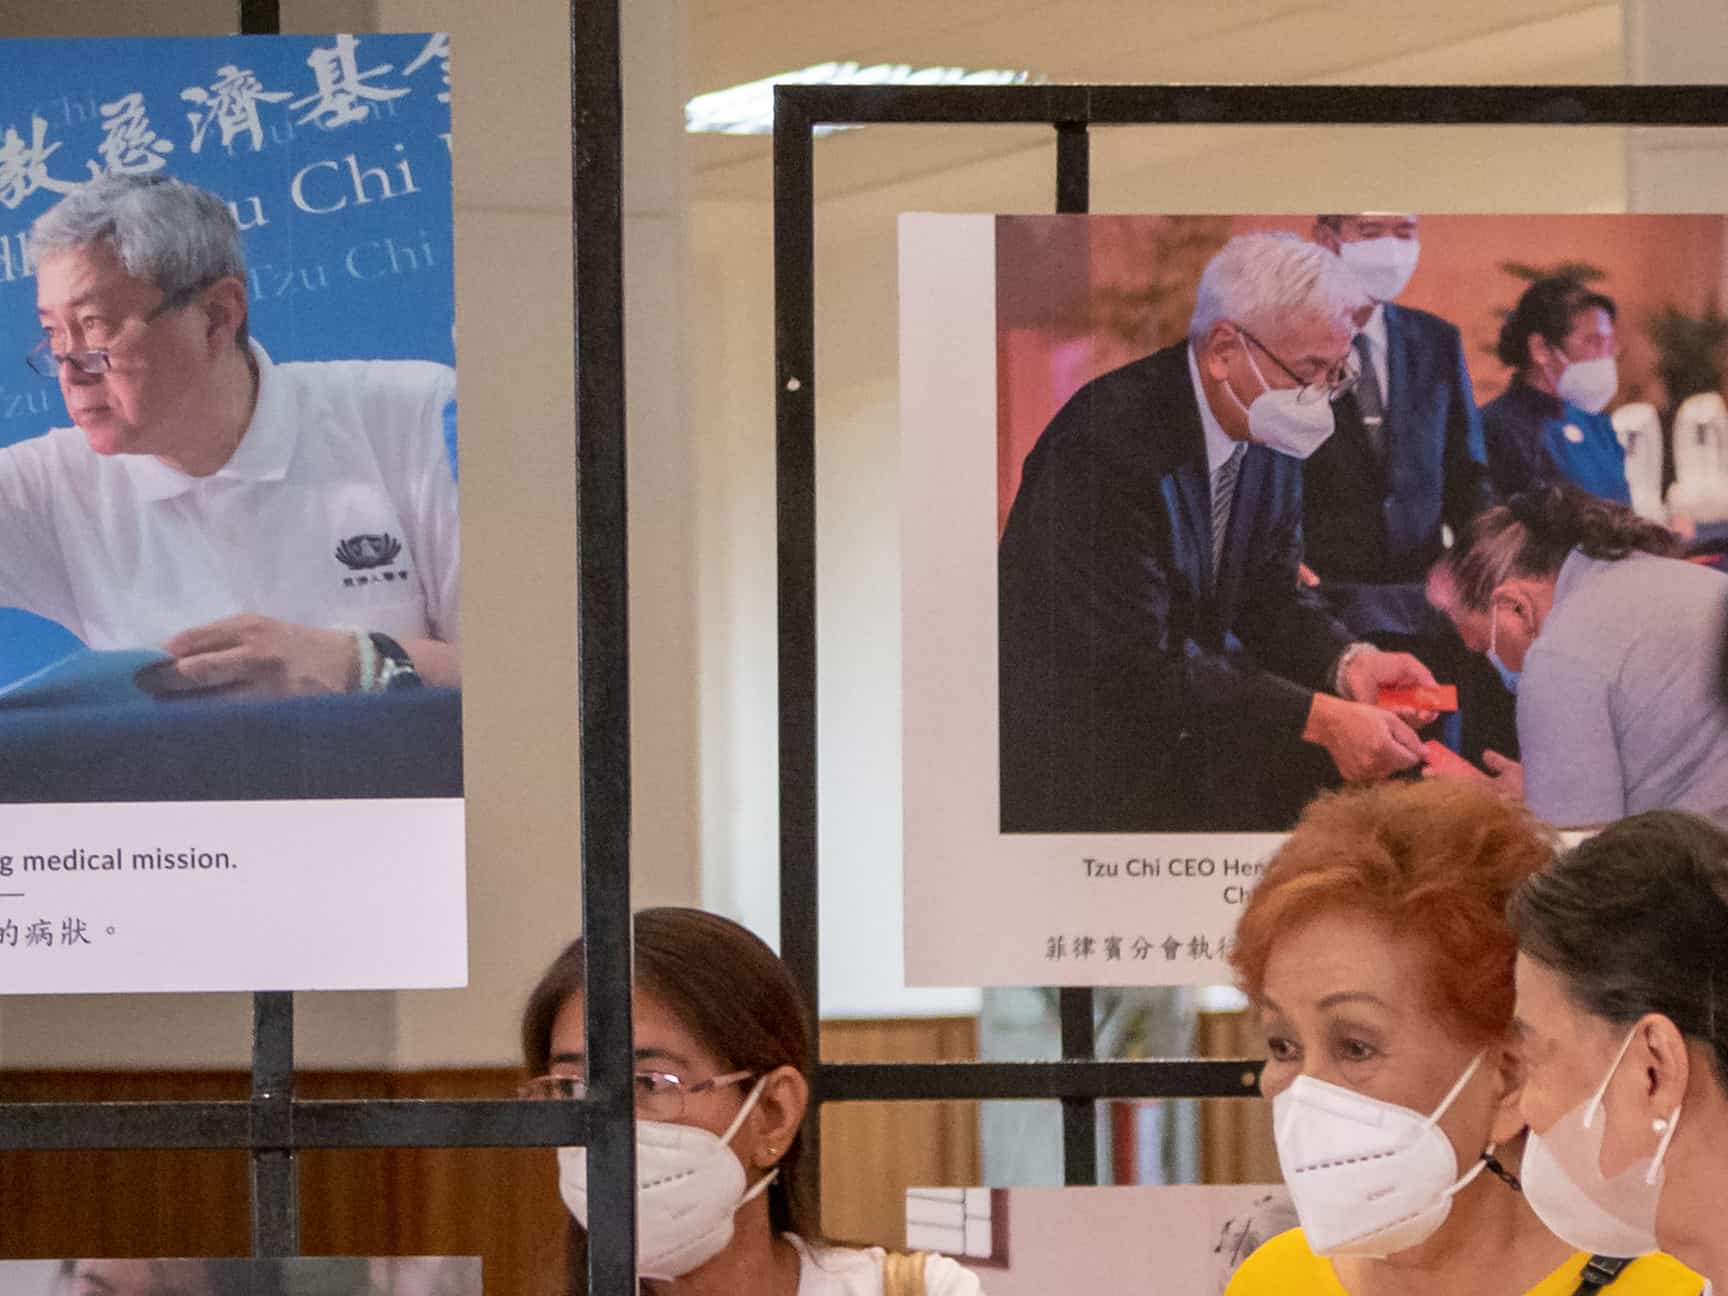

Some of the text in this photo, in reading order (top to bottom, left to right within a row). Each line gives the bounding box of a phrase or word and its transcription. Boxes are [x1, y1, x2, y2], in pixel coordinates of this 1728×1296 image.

[291, 144, 420, 213] Chi
[346, 229, 436, 281] Chi
[23, 848, 122, 872] medical
[132, 847, 238, 871] mission.
[1083, 858, 1118, 878] Tzu
[1126, 857, 1161, 878] Chi
[1168, 857, 1216, 878] CEO
